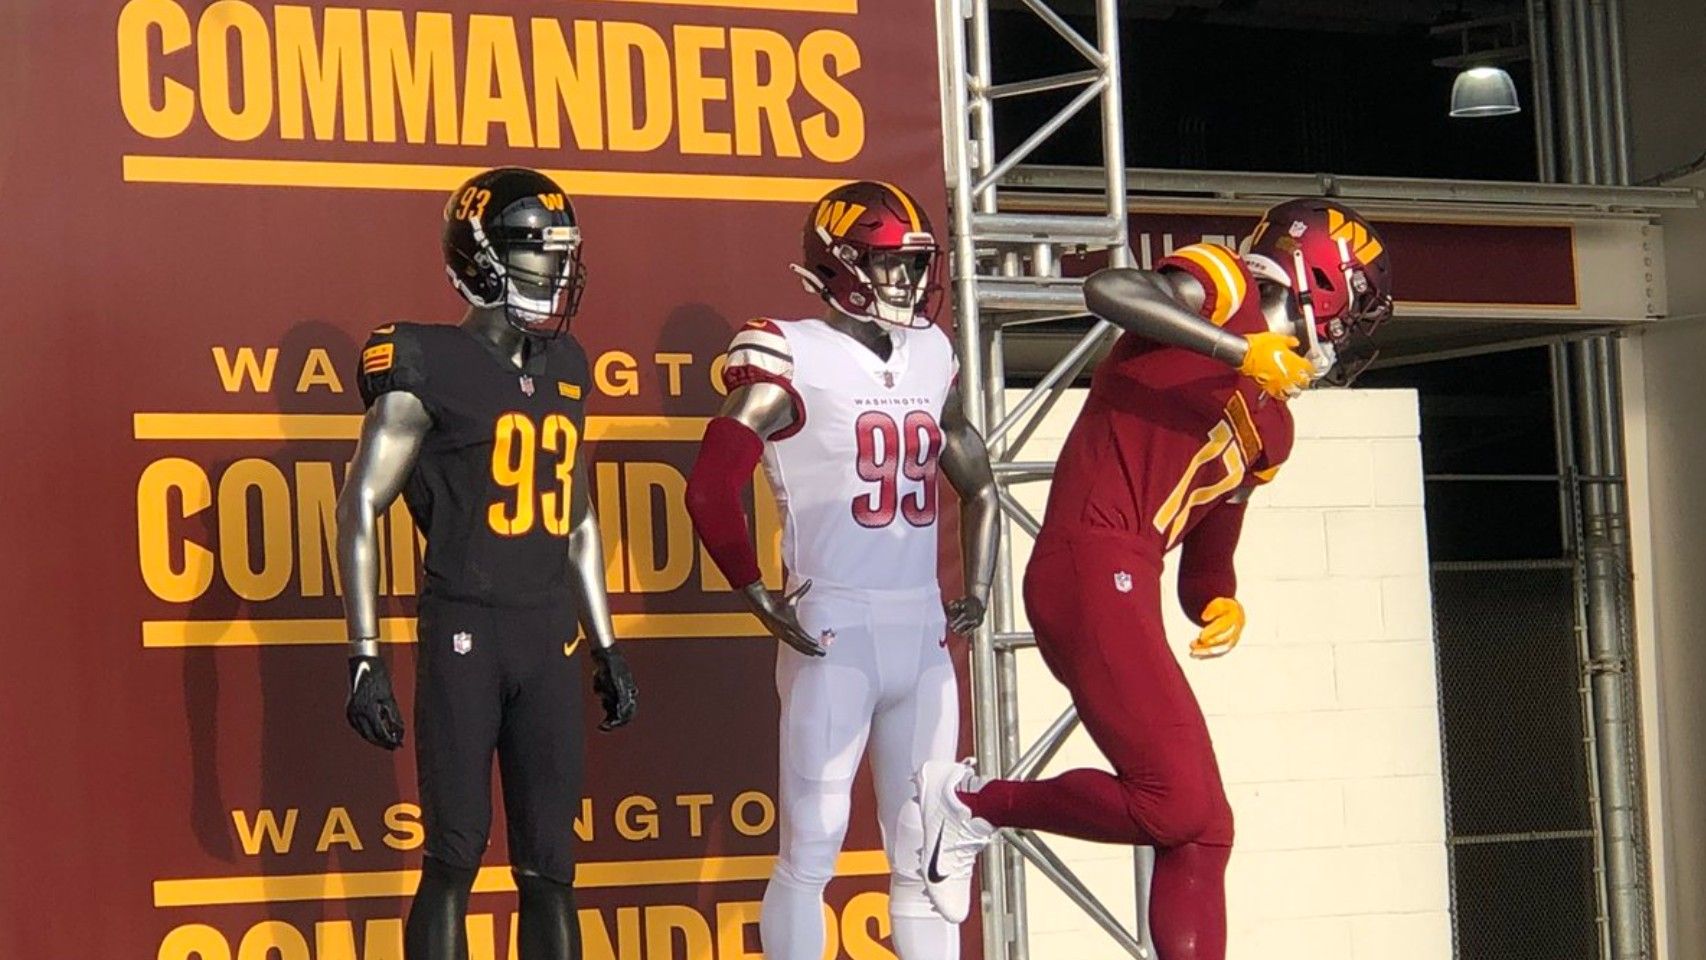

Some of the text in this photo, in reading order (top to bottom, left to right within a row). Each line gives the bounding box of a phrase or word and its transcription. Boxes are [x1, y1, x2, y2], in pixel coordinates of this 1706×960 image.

[117, 0, 865, 163] COMMANDERS
[456, 186, 492, 221] 93
[854, 397, 931, 406] WASHINGTON
[487, 412, 578, 536] 93
[851, 409, 942, 529] 99
[1152, 419, 1246, 550] 17
[232, 791, 776, 856] WASGTO
